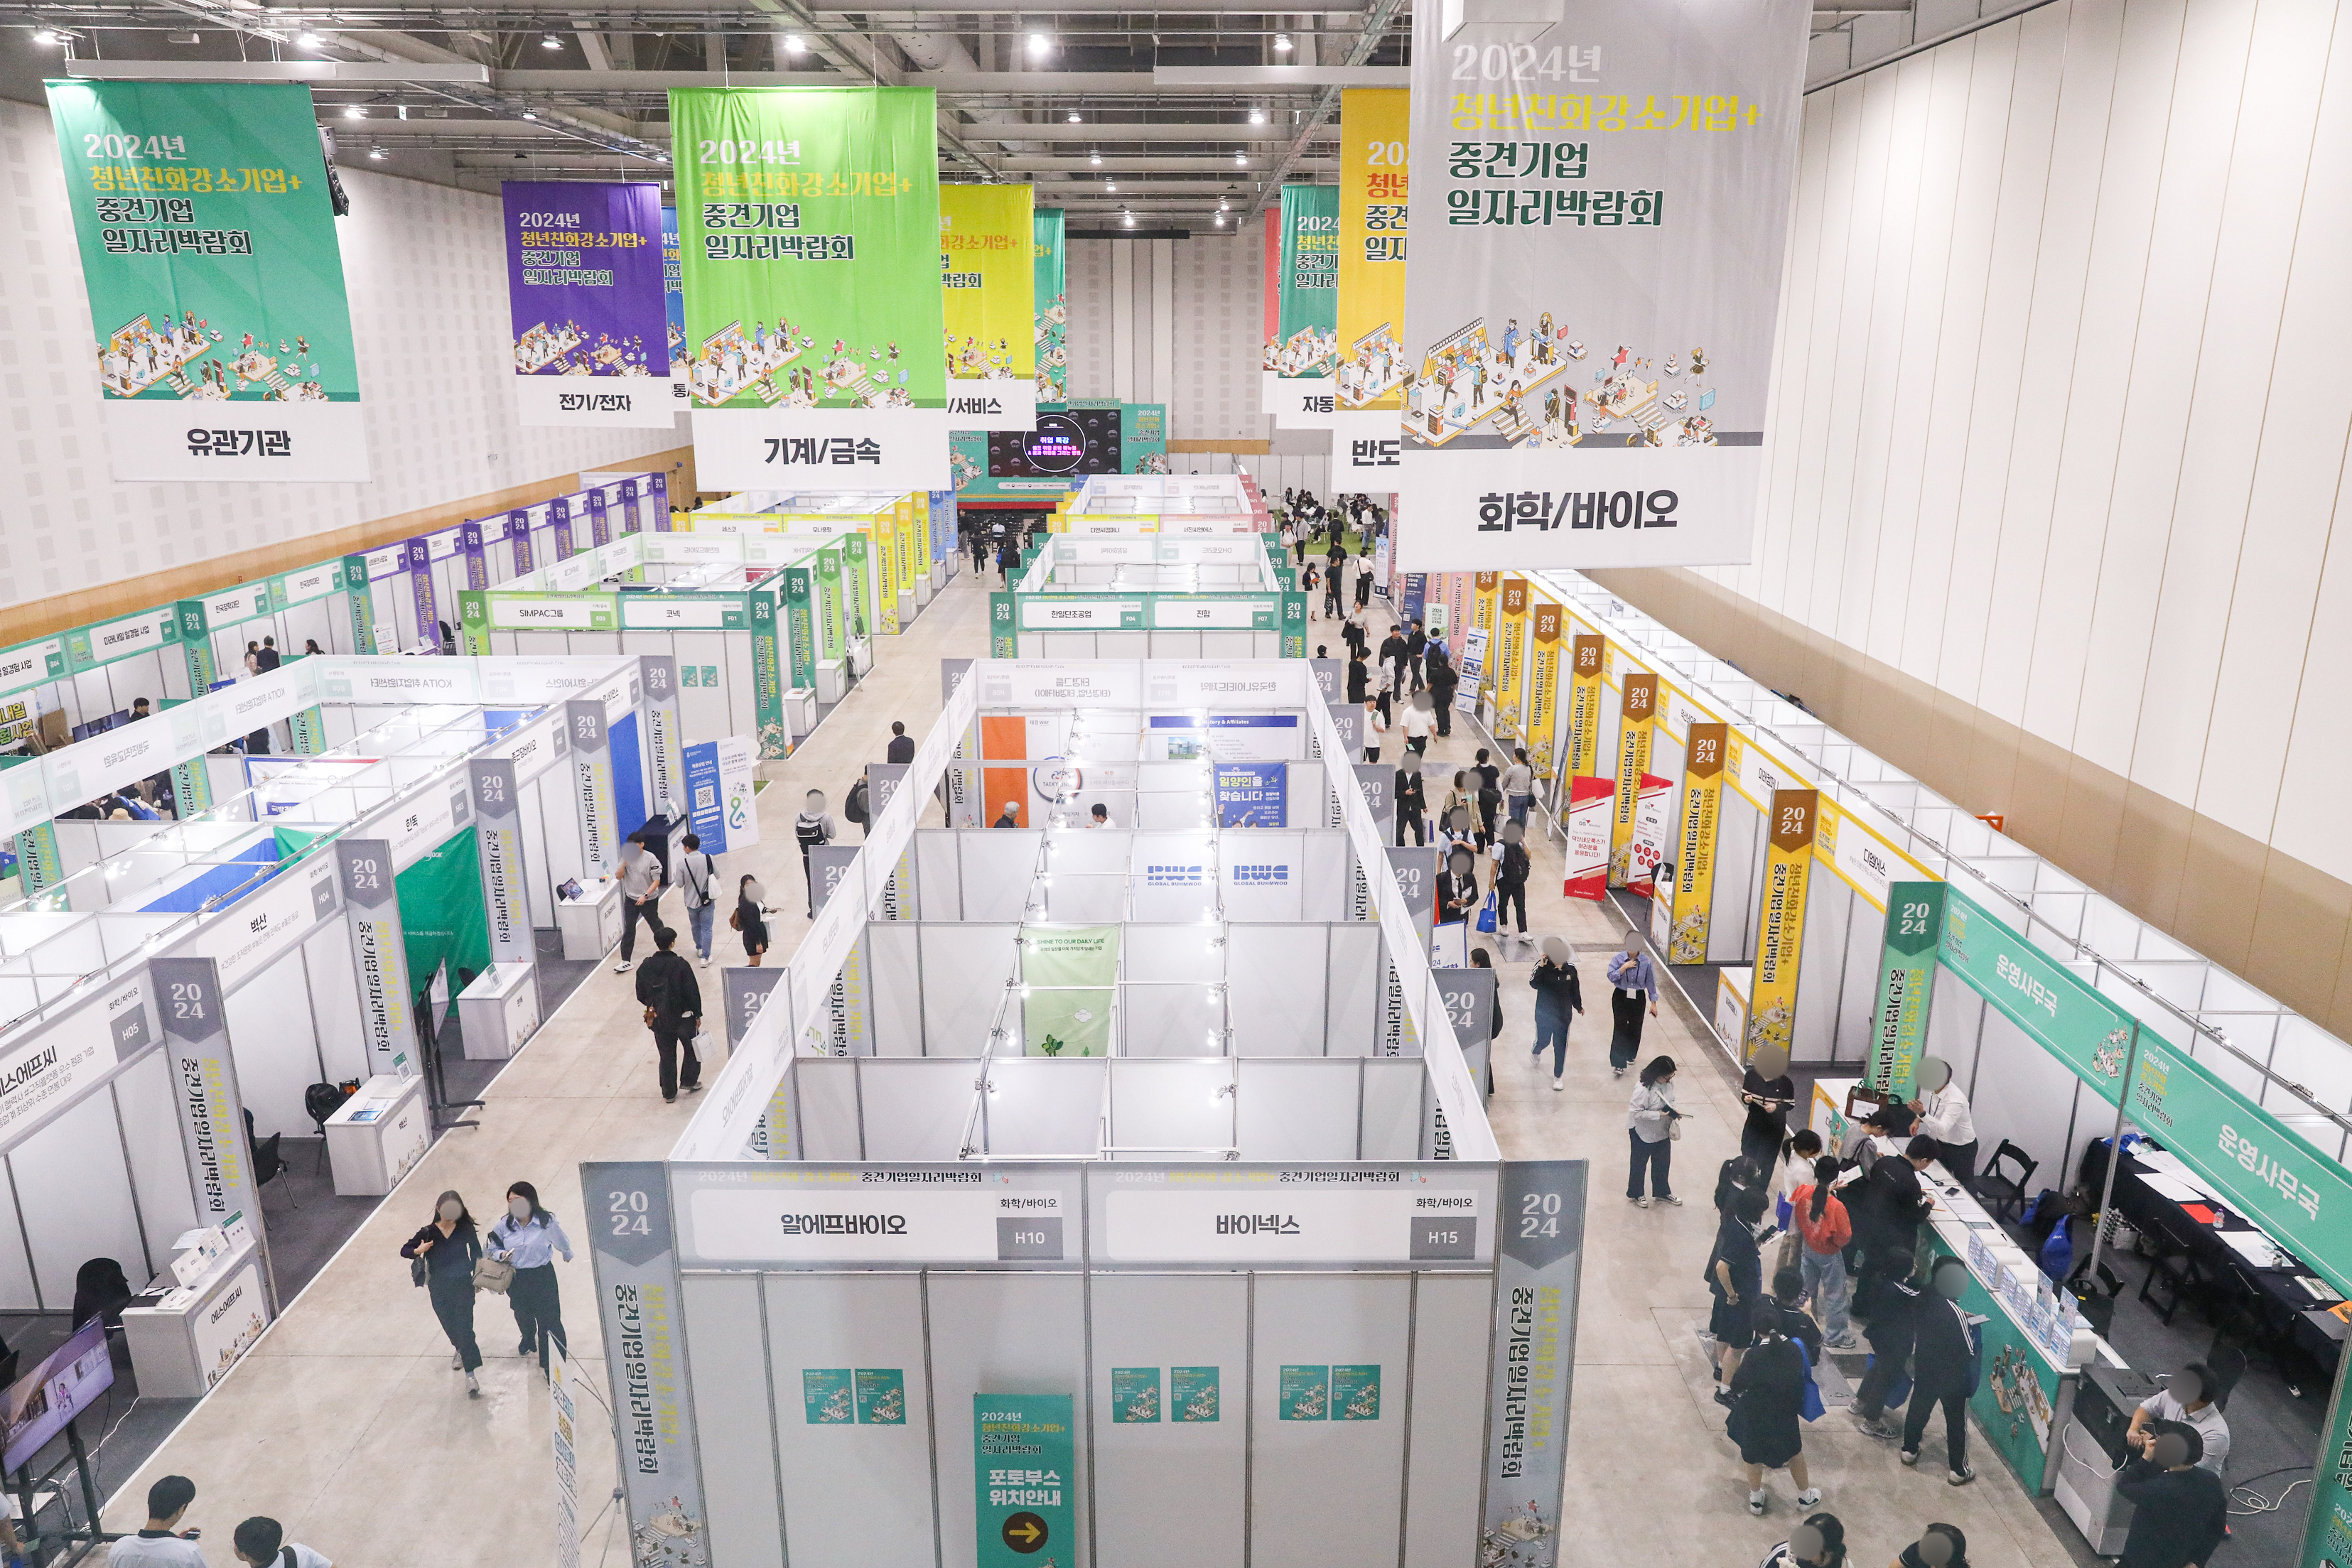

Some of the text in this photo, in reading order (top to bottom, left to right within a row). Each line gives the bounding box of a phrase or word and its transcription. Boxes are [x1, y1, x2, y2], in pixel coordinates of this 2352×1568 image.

[1452, 44, 1602, 83] 2024년
[1450, 93, 1763, 131] 청년친화강소기업+
[83, 134, 186, 161] 2024년
[699, 140, 800, 165] 2024년
[1447, 142, 1589, 179] 중견기업
[90, 166, 303, 193] 청년친화강소기업+
[701, 171, 912, 197] 청년친화강소기업+
[95, 198, 195, 223] 중견기업
[703, 203, 800, 229] 중견기업
[1447, 188, 1663, 227] 일자리박람회
[519, 212, 581, 228] 2024년
[102, 228, 253, 255] 일자리박람회
[521, 231, 647, 248] 청년친화강소기업+
[704, 234, 854, 261] 일자리박람회
[522, 250, 581, 266] 중견기업
[1296, 254, 1339, 270] 중견기
[523, 269, 613, 286] 일자리박람회
[559, 394, 631, 411] 전기/전자
[1302, 396, 1334, 413] 자동
[187, 429, 291, 457] 유관기관
[764, 438, 880, 465] 기계/금속
[1352, 438, 1400, 467] 반도
[1478, 488, 1678, 531] 화학/바이오
[300, 578, 320, 589] 한국장학재단
[216, 600, 239, 614] 한국장학재단
[519, 610, 563, 618] SIMPAC그룹
[667, 610, 680, 618] 코넥
[1051, 610, 1091, 619] 한일단조공업
[1197, 610, 1210, 618] 진합
[1541, 615, 1555, 624] 20
[1541, 624, 1554, 632] 24
[104, 625, 150, 646] 미래내일 일경험 사업
[1502, 622, 1513, 691] 중견기업일자리박람회
[1581, 647, 1597, 656] 20
[2, 659, 32, 676] 일경험 사업
[1580, 657, 1596, 666] 24
[1632, 688, 1649, 698] 20
[1631, 698, 1648, 709] 24
[1697, 740, 1717, 750] 20
[1696, 752, 1715, 763] 24
[1219, 777, 1263, 787] 일양인을
[1219, 791, 1263, 801] 찾습니다
[455, 802, 464, 813] H03
[1783, 807, 1806, 820] 20
[406, 814, 419, 833] 한독
[1781, 821, 1803, 834] 24
[1572, 836, 1606, 845] 덕산네오룩스가
[310, 863, 329, 878] 화학/바이오
[1863, 848, 1886, 877] 디엠에스
[486, 829, 510, 943] 중견기업일자리박람회
[318, 892, 330, 904] H04
[1903, 902, 1930, 918] 20
[1951, 905, 1967, 922] 2024년
[250, 913, 268, 934] 벽산
[1900, 919, 1926, 934] 24
[358, 921, 390, 1052] 중견기업일자리박람회
[1996, 954, 2058, 1018] 운영사무국
[109, 987, 139, 1011] 화학/바이오
[122, 1022, 139, 1041] H05
[1874, 968, 1906, 1093] 중견기업일자리박람
[2144, 1049, 2170, 1074] 2024년
[4, 1045, 95, 1110] 협력사 #구직플랫폼 우수 평점 기업
[16, 1073, 72, 1117] 최상위 수준 연봉 대우
[2138, 1081, 2163, 1105] 중견기업
[2136, 1091, 2174, 1128] 일자리박람회
[181, 1056, 226, 1213] 중견기업일자리박람회
[698, 1172, 747, 1183] 2024년
[861, 1172, 982, 1184] 중견기업일자리박람회
[1116, 1172, 1165, 1183] 2024년
[1279, 1172, 1401, 1184] 중견기업일자리박람회
[2218, 1124, 2320, 1221] 운영사무국
[609, 1191, 649, 1213] 20
[1000, 1198, 1057, 1209] 화학/바이오
[1416, 1198, 1474, 1209] 화학/바이오
[1522, 1194, 1561, 1215] 20
[612, 1215, 652, 1236] 24
[780, 1214, 907, 1235] 알에프바이오
[1217, 1214, 1300, 1235] 바이넥스
[1520, 1217, 1560, 1238] 24
[1015, 1232, 1045, 1244] H10
[1428, 1231, 1458, 1244] H15
[211, 1286, 242, 1324] 에스에프씨
[615, 1283, 659, 1475] 중견기업일자리박람회
[1501, 1287, 1534, 1479] 중견기업일자리박람회
[981, 1412, 1022, 1421] 2024년
[981, 1434, 1020, 1443] 중견기업
[981, 1445, 1042, 1454] 일자리박람회
[989, 1470, 1060, 1486] 포토부스
[989, 1490, 1061, 1506] 위치안내
